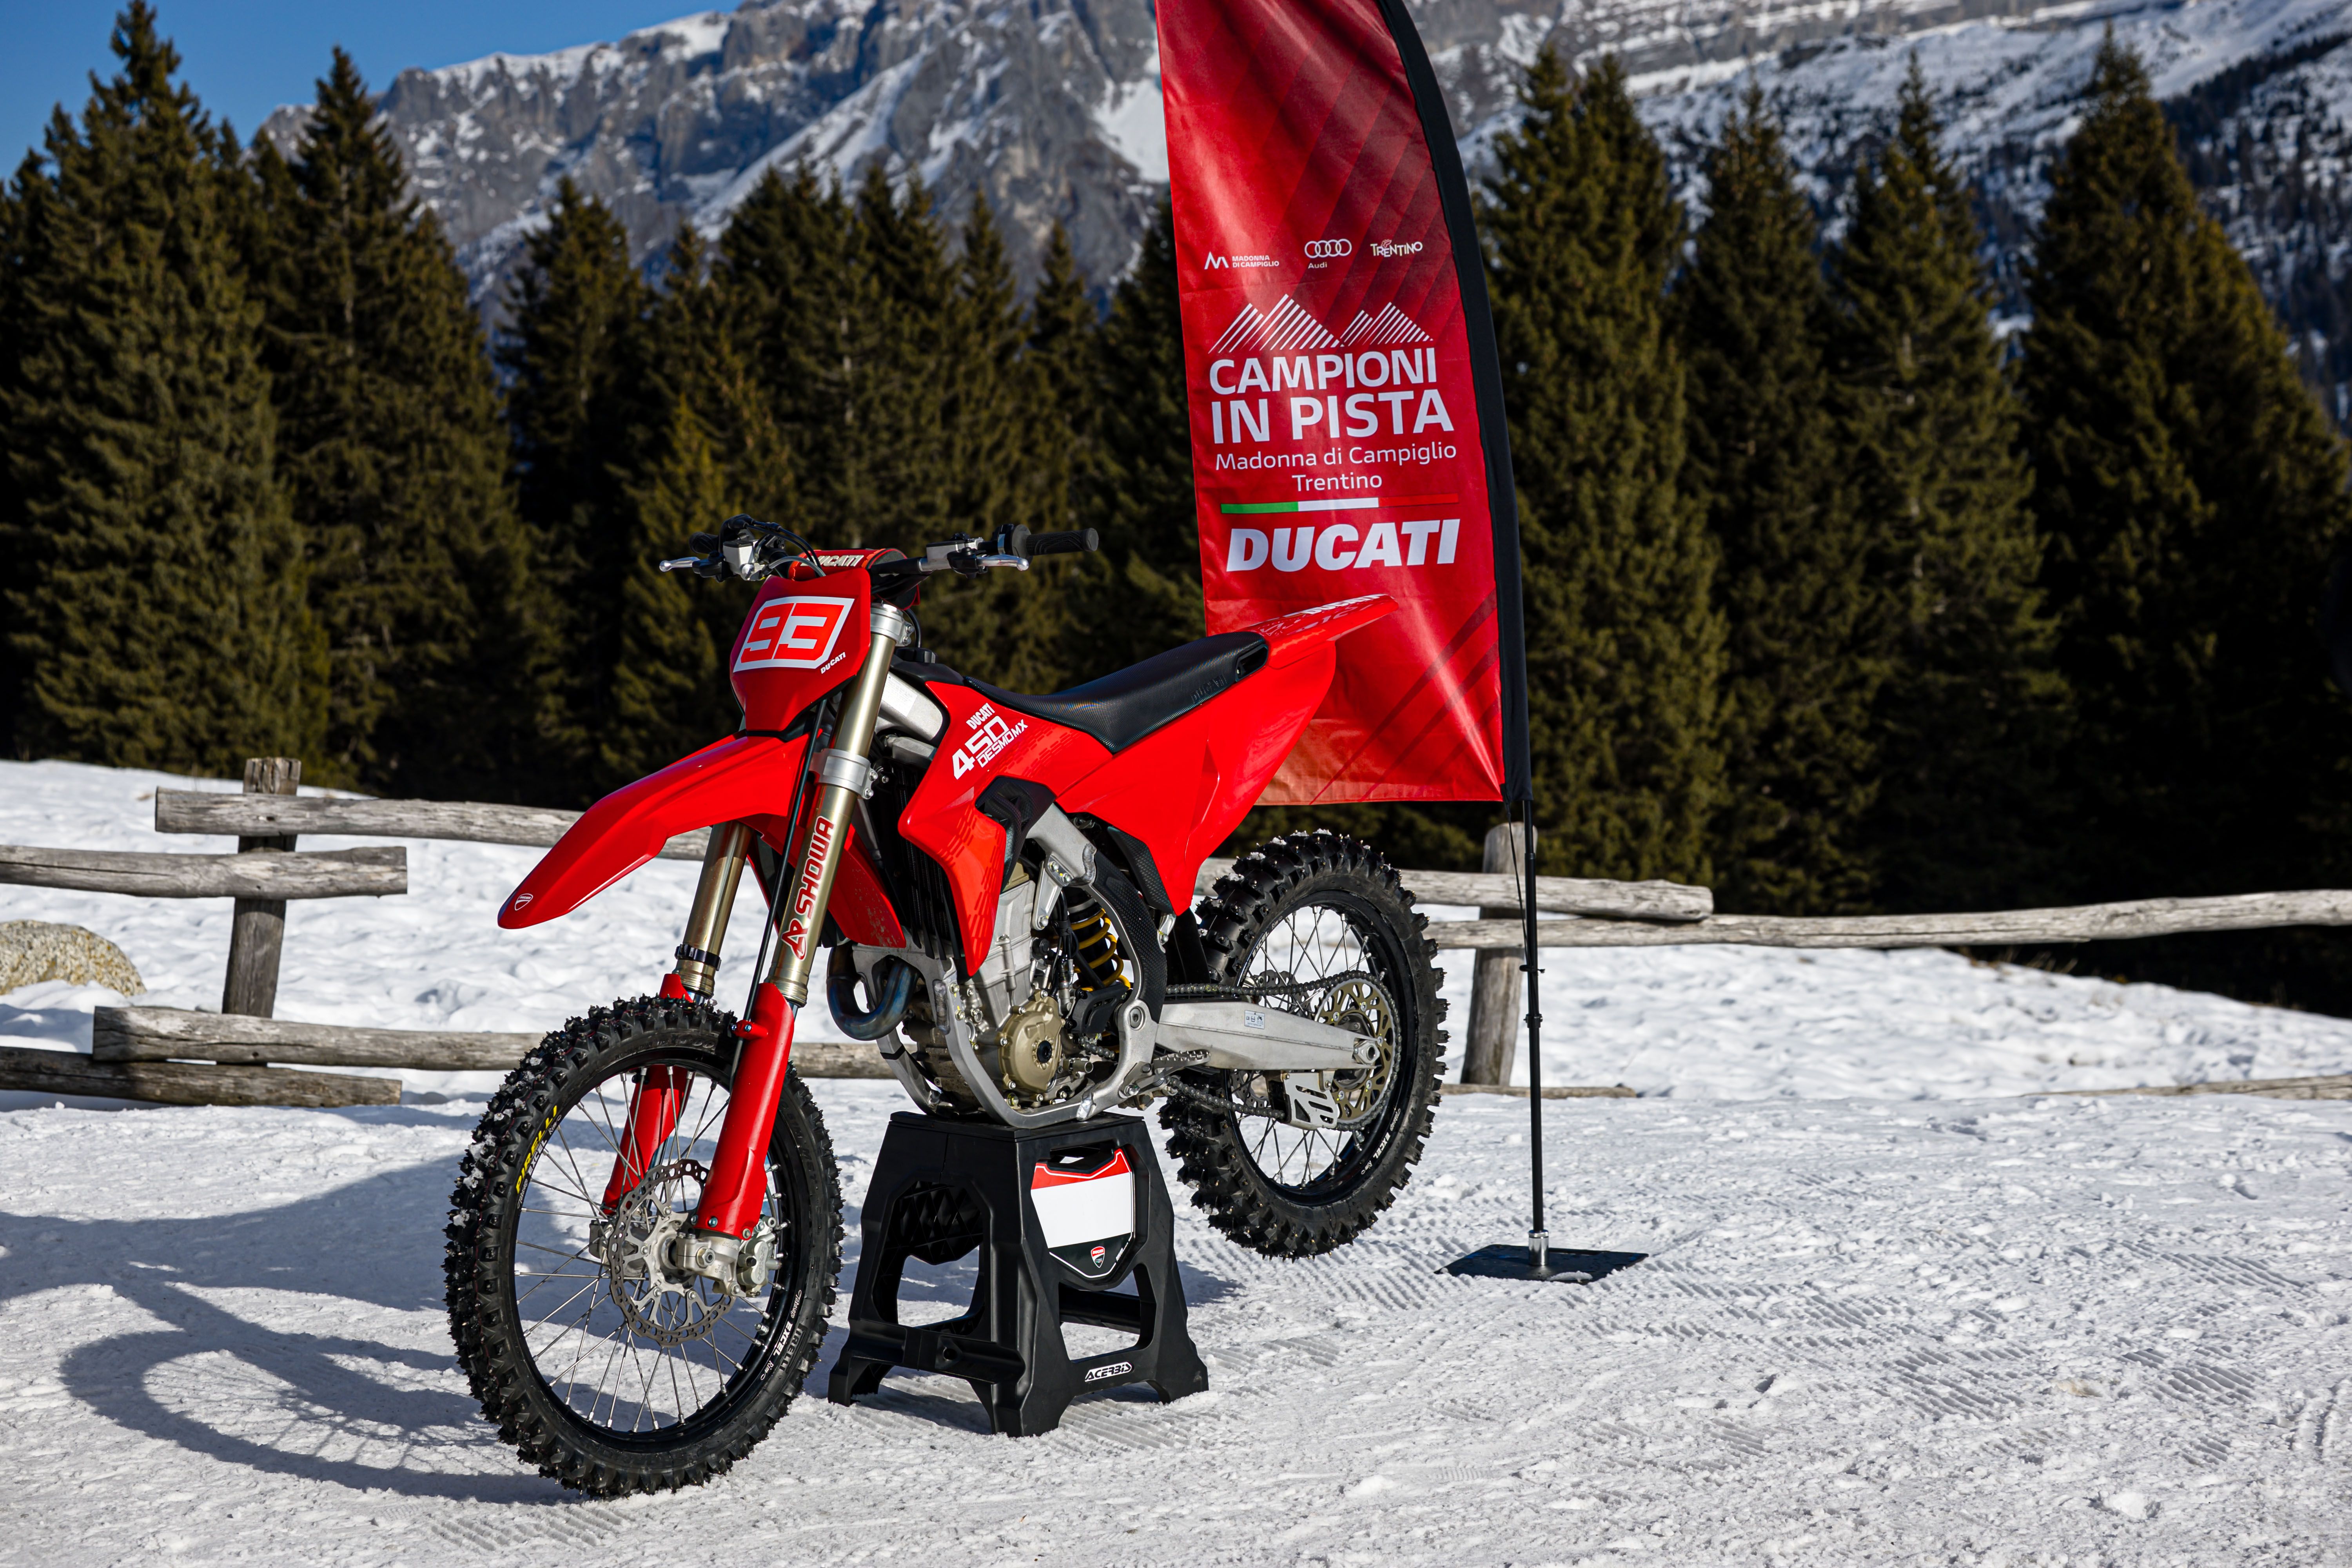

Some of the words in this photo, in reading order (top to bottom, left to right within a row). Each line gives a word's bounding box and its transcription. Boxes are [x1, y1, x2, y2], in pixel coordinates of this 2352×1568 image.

[1370, 241, 1423, 257] TRENTINO
[1209, 348, 1437, 395] CAMPIONI
[1212, 399, 1270, 444] IN
[1290, 389, 1454, 440] PISTA
[1216, 451, 1317, 470] Madonna
[1323, 447, 1342, 465] di
[1349, 442, 1456, 466] Campiglio
[1292, 472, 1382, 492] Trentino
[1226, 519, 1460, 572] DUCATI
[740, 603, 844, 663] 93
[820, 652, 846, 674] DUCATI
[966, 703, 995, 730] DUCATI
[952, 716, 1009, 780] 450
[795, 816, 835, 920] SHOWA
[516, 1105, 557, 1194] PIRELLI
[527, 1140, 547, 1176] EXCEL
[548, 1114, 562, 1135] Rim
[1373, 1132, 1391, 1159] EXCEL
[791, 1290, 802, 1319] Takasago
[773, 1321, 793, 1356] EXCEL
[760, 1360, 774, 1381] Rim
